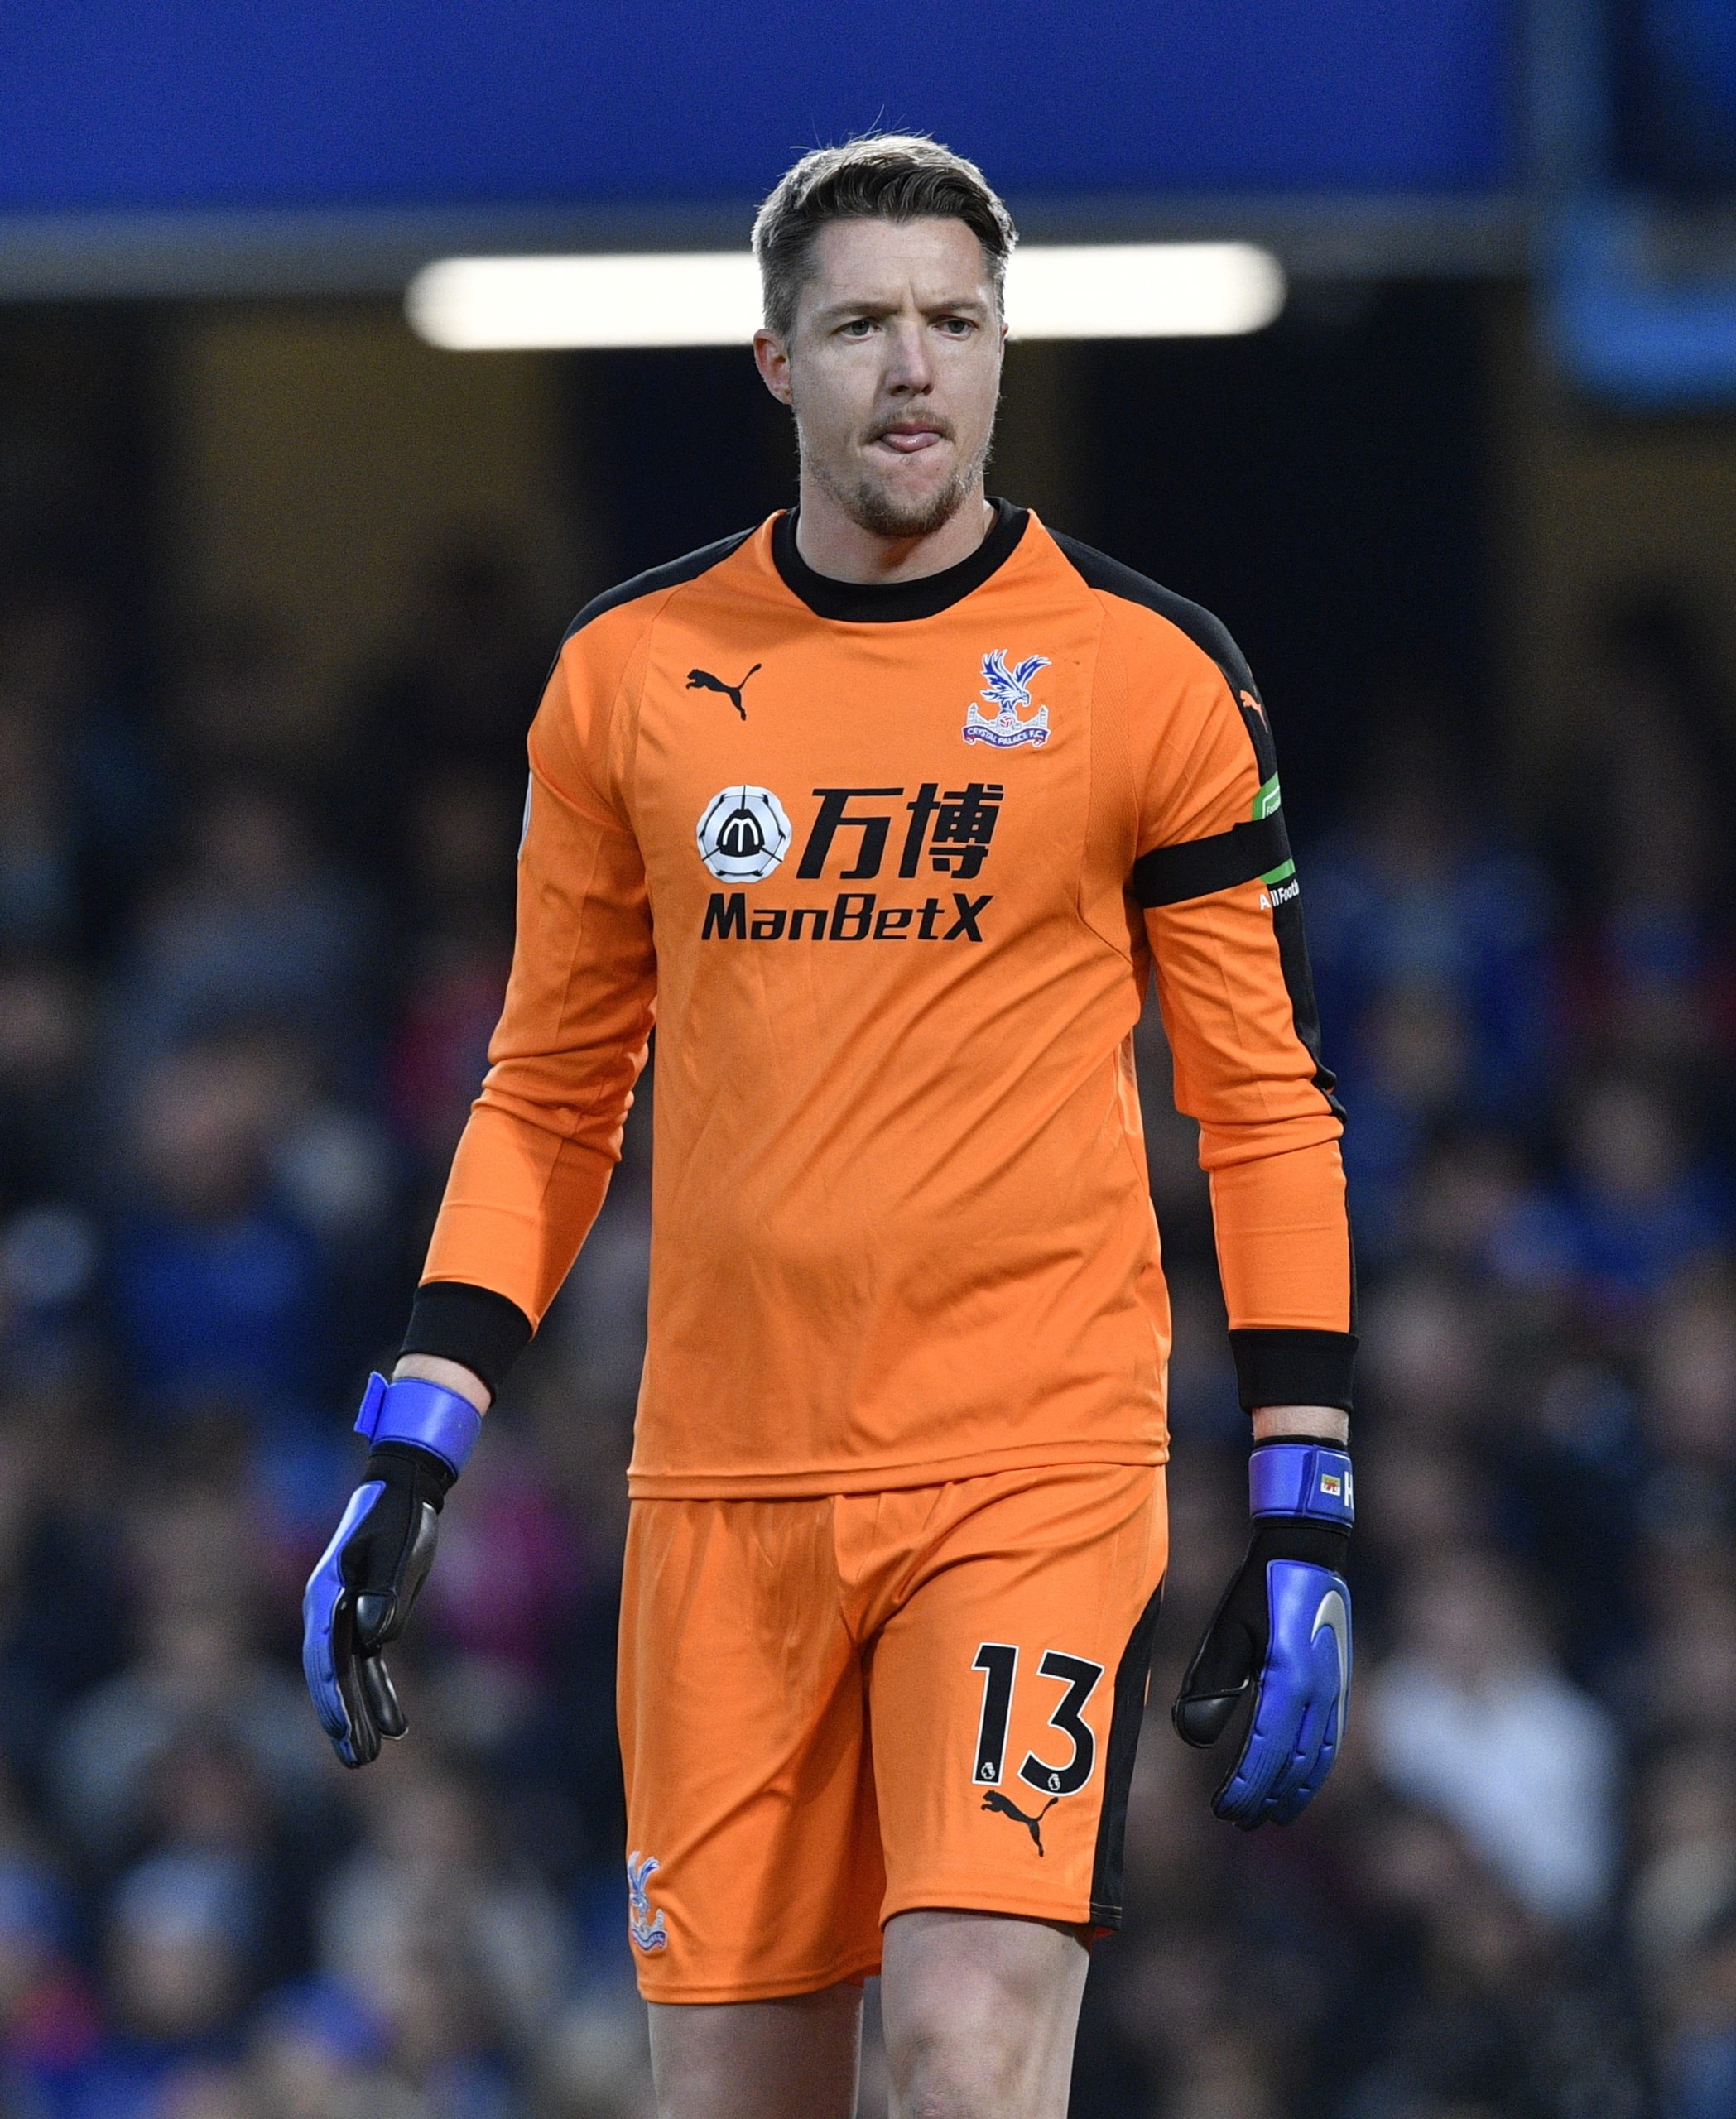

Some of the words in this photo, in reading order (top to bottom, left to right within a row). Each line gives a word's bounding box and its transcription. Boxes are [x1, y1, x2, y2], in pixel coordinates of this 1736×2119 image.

[967, 728, 997, 743] CRYSTAL
[998, 732, 1028, 745] PALACE
[796, 783, 1004, 880] 万博
[701, 892, 994, 943] ManBetX
[970, 1641, 1106, 1797] 13
